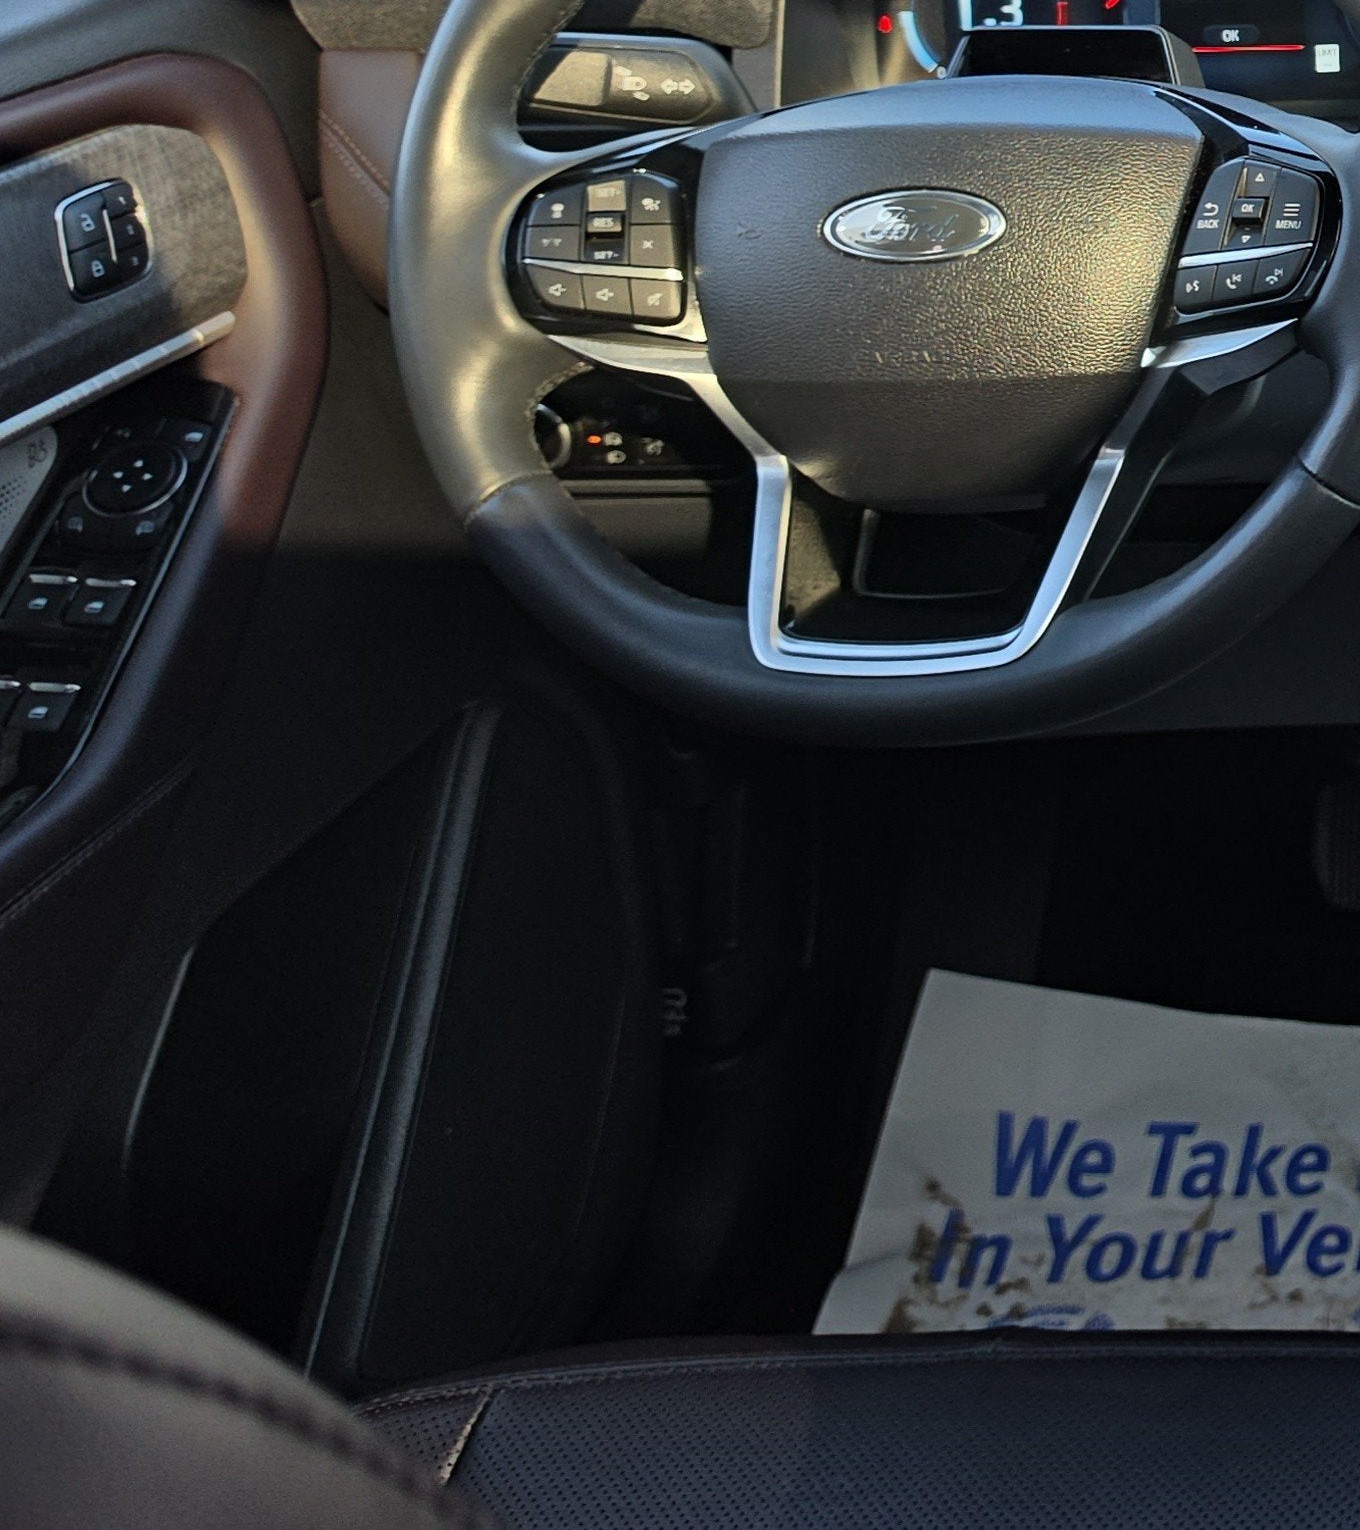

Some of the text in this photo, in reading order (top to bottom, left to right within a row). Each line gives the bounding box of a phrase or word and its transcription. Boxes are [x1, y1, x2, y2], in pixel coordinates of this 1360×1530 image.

[1240, 203, 1255, 214] OK
[1196, 219, 1220, 230] BACK
[1275, 219, 1302, 230] MENU
[995, 1110, 1117, 1199] We
[1146, 1120, 1332, 1199] Take
[929, 1208, 1013, 1289] In
[1045, 1213, 1237, 1284] Your
